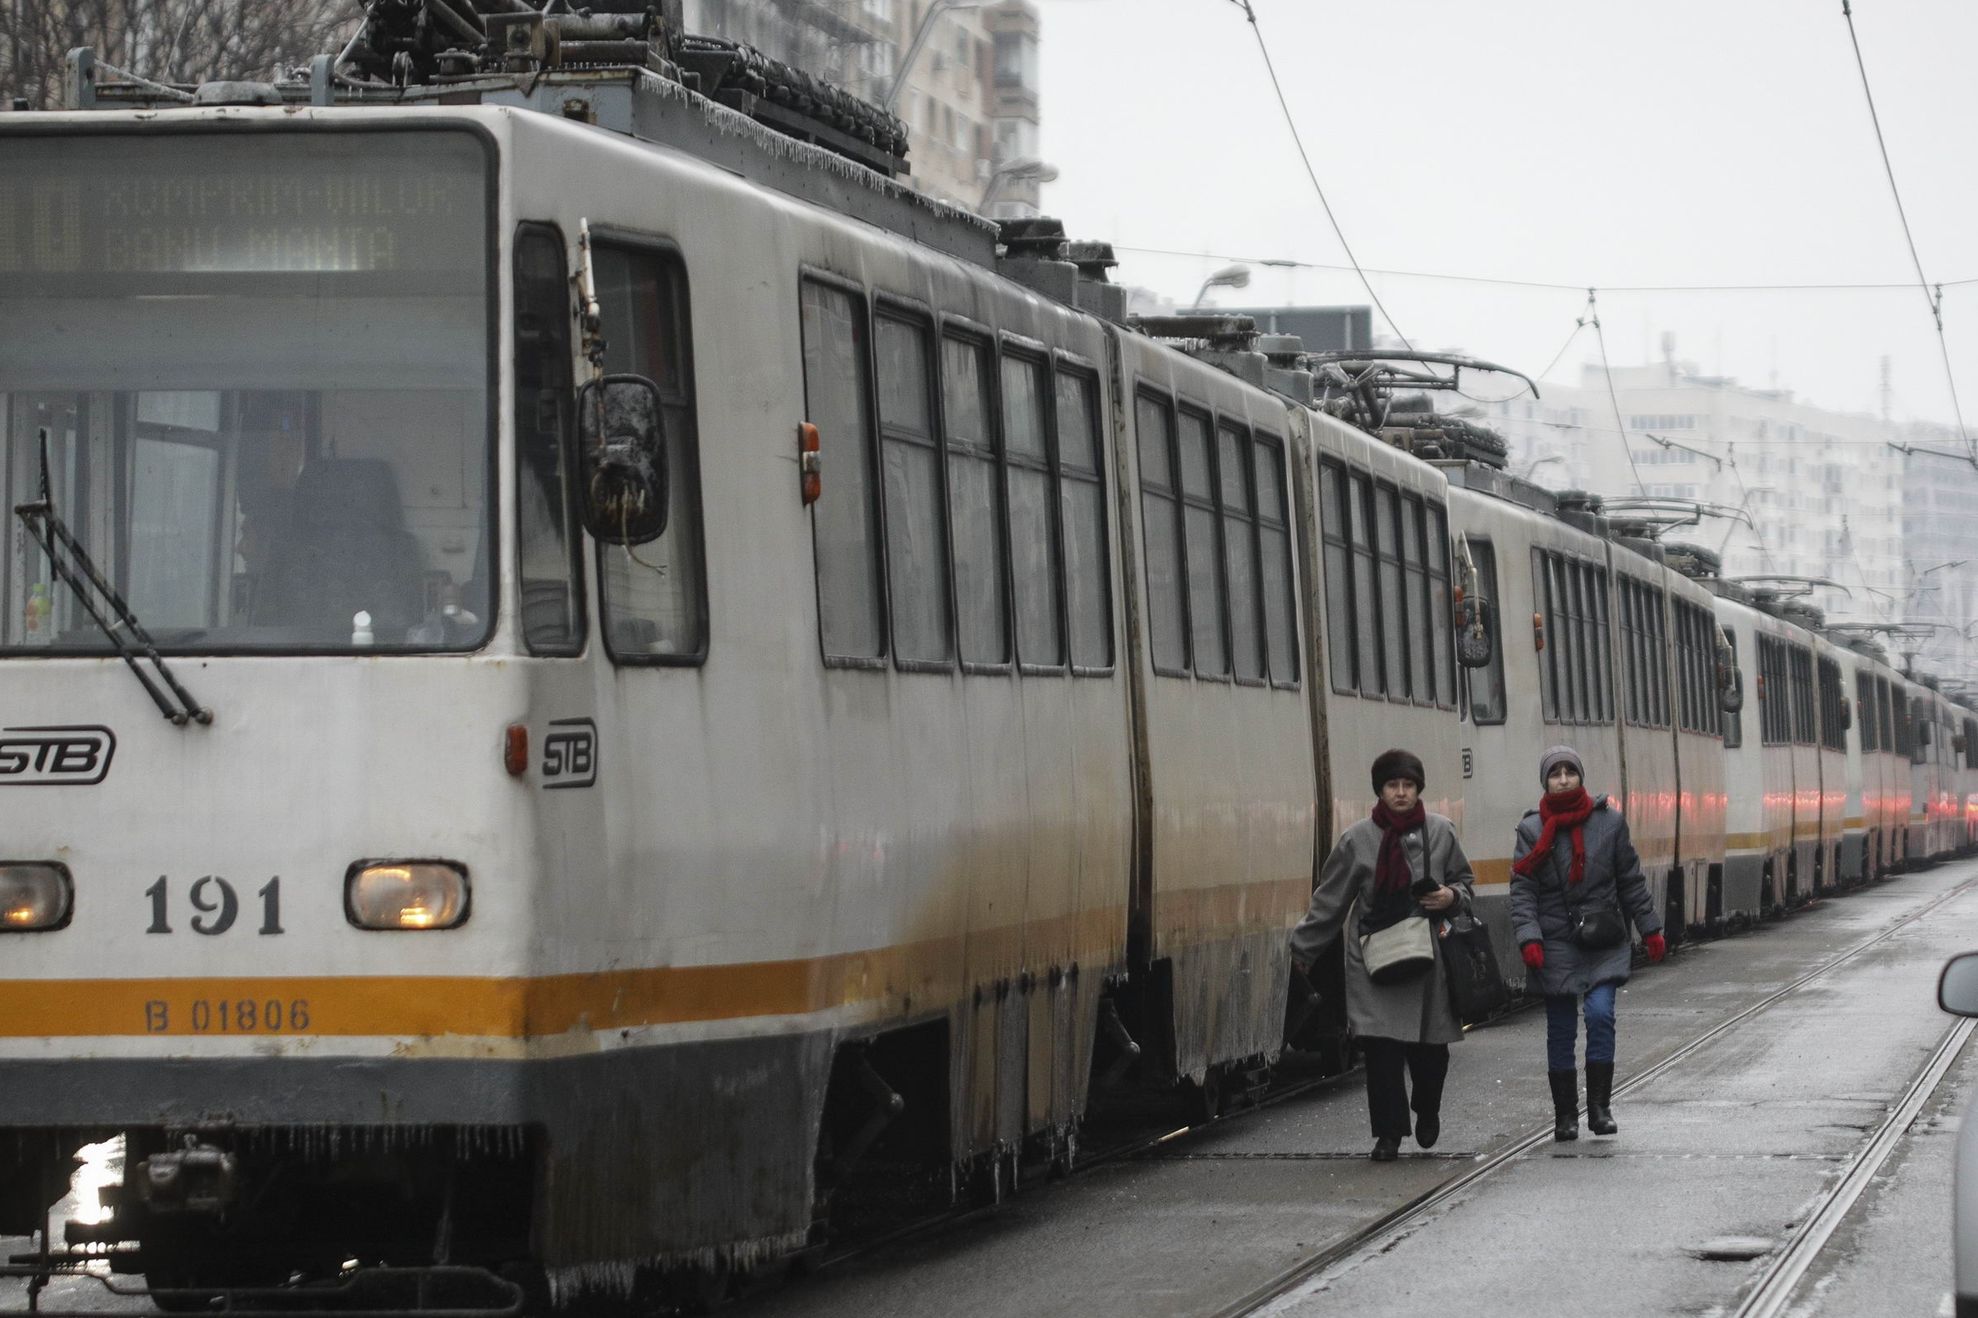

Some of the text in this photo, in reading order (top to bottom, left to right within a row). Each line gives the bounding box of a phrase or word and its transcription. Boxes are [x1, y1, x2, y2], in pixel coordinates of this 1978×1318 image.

[0, 737, 102, 774] STB
[542, 732, 592, 776] STB
[145, 874, 286, 936] 191
[145, 999, 310, 1032] B 01806
